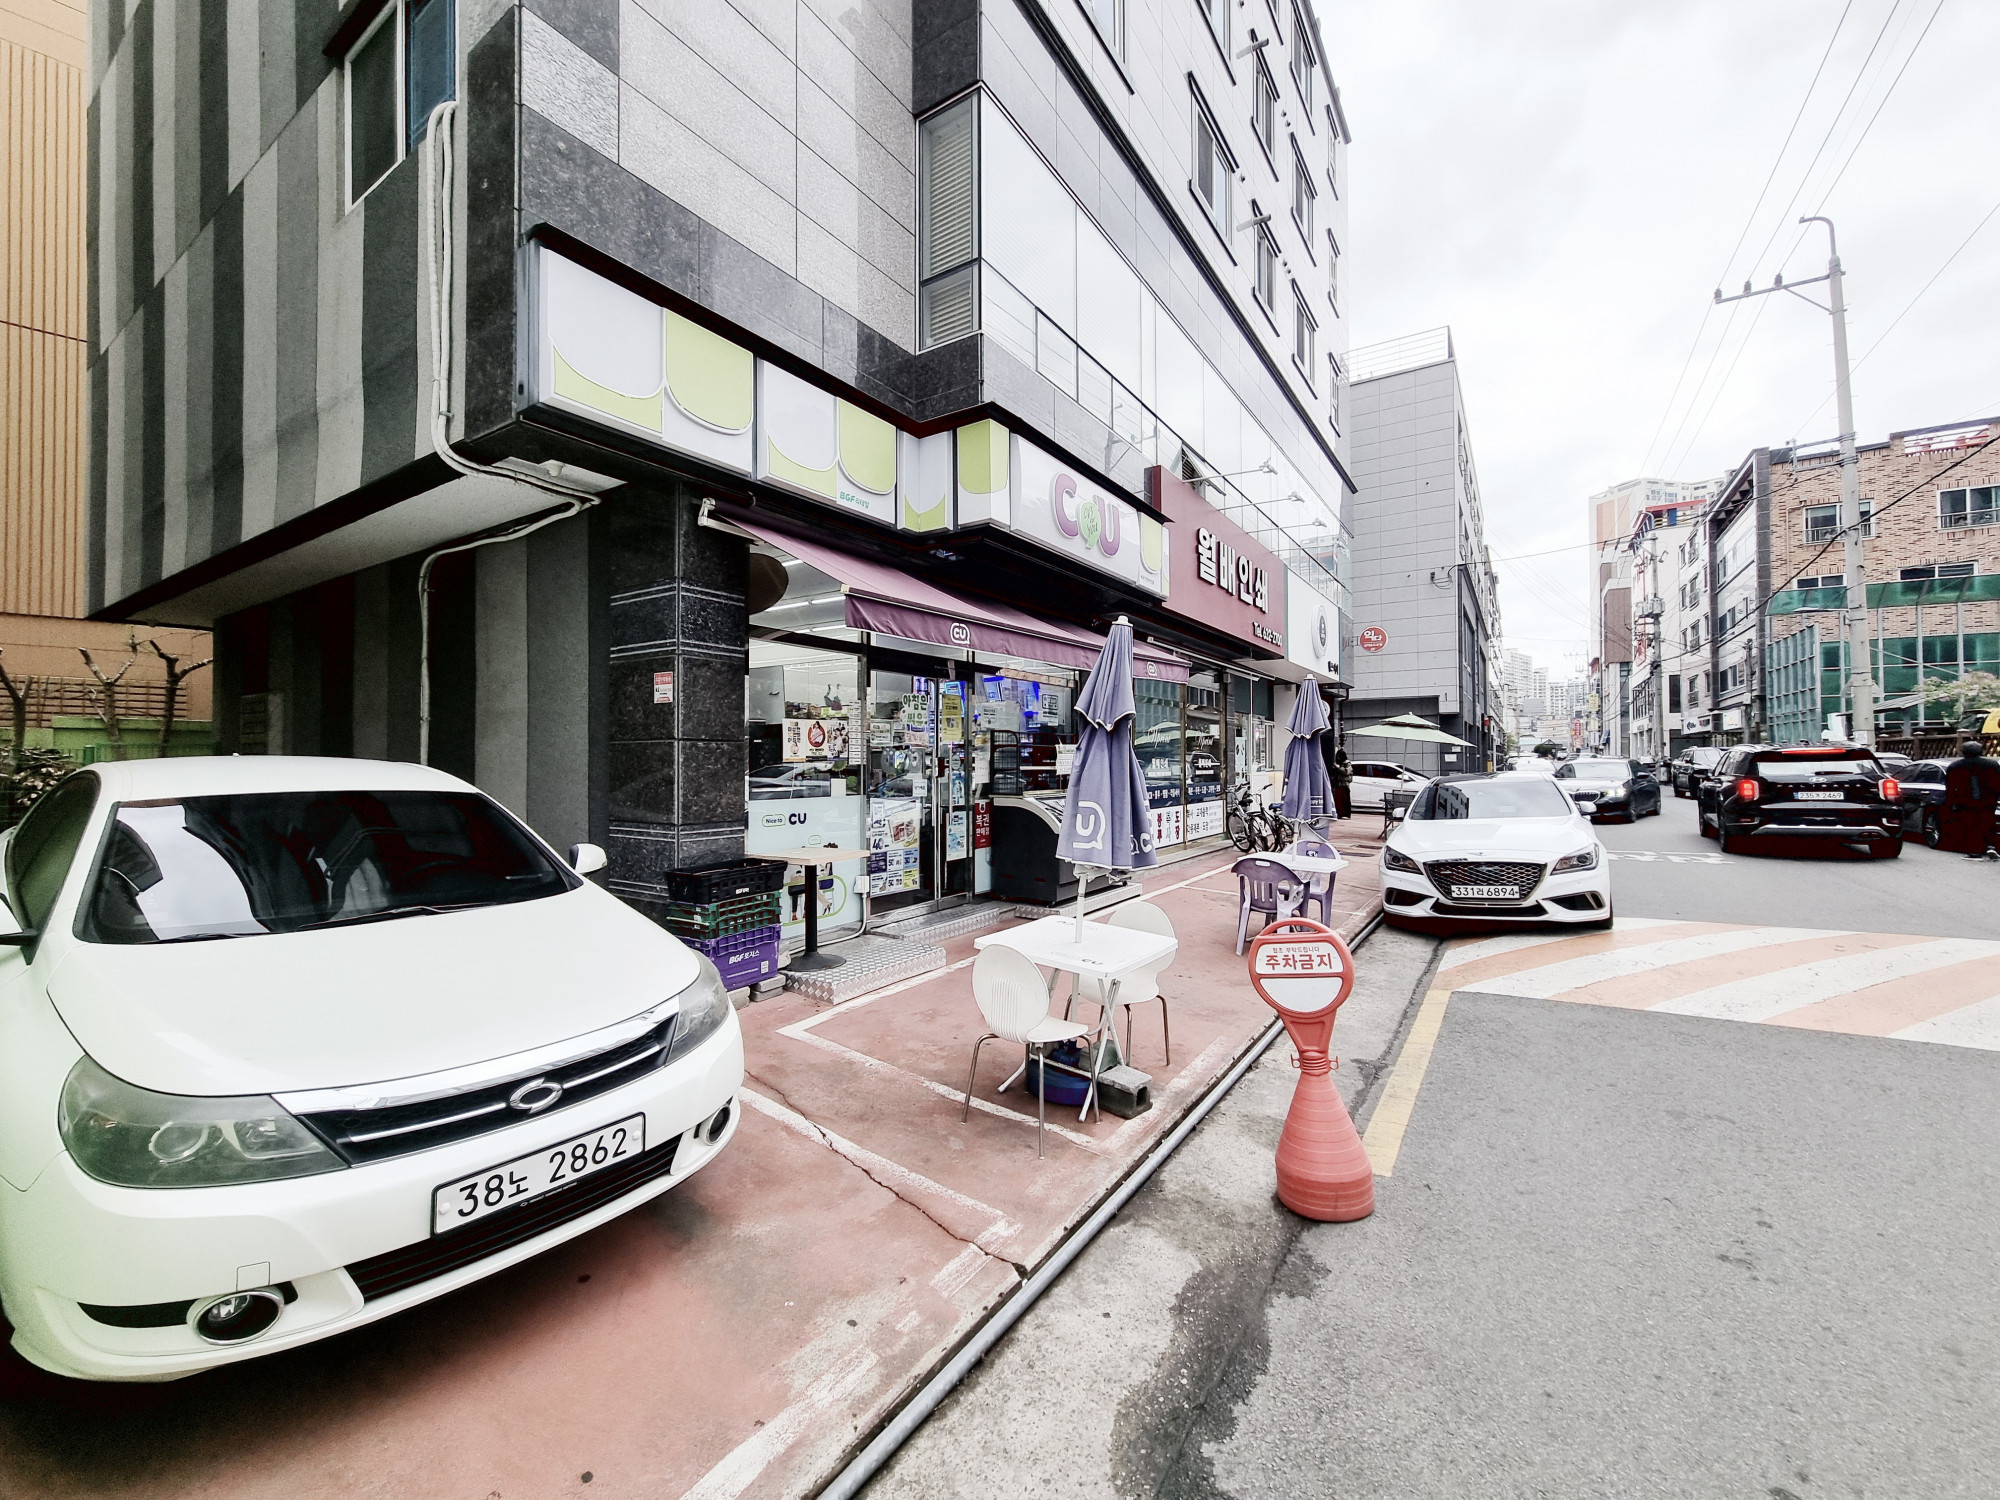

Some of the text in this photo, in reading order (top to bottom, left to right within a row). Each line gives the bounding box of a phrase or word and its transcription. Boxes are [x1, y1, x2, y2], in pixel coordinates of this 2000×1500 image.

[1053, 473, 1121, 556] CU
[1197, 527, 1269, 614] 월배인쇄
[903, 694, 928, 711] 아침은
[788, 812, 807, 825] CU
[976, 813, 990, 827] 복권
[1265, 952, 1333, 971] 주차금지
[457, 1170, 530, 1218] 38노
[549, 1127, 628, 1184] 2862
